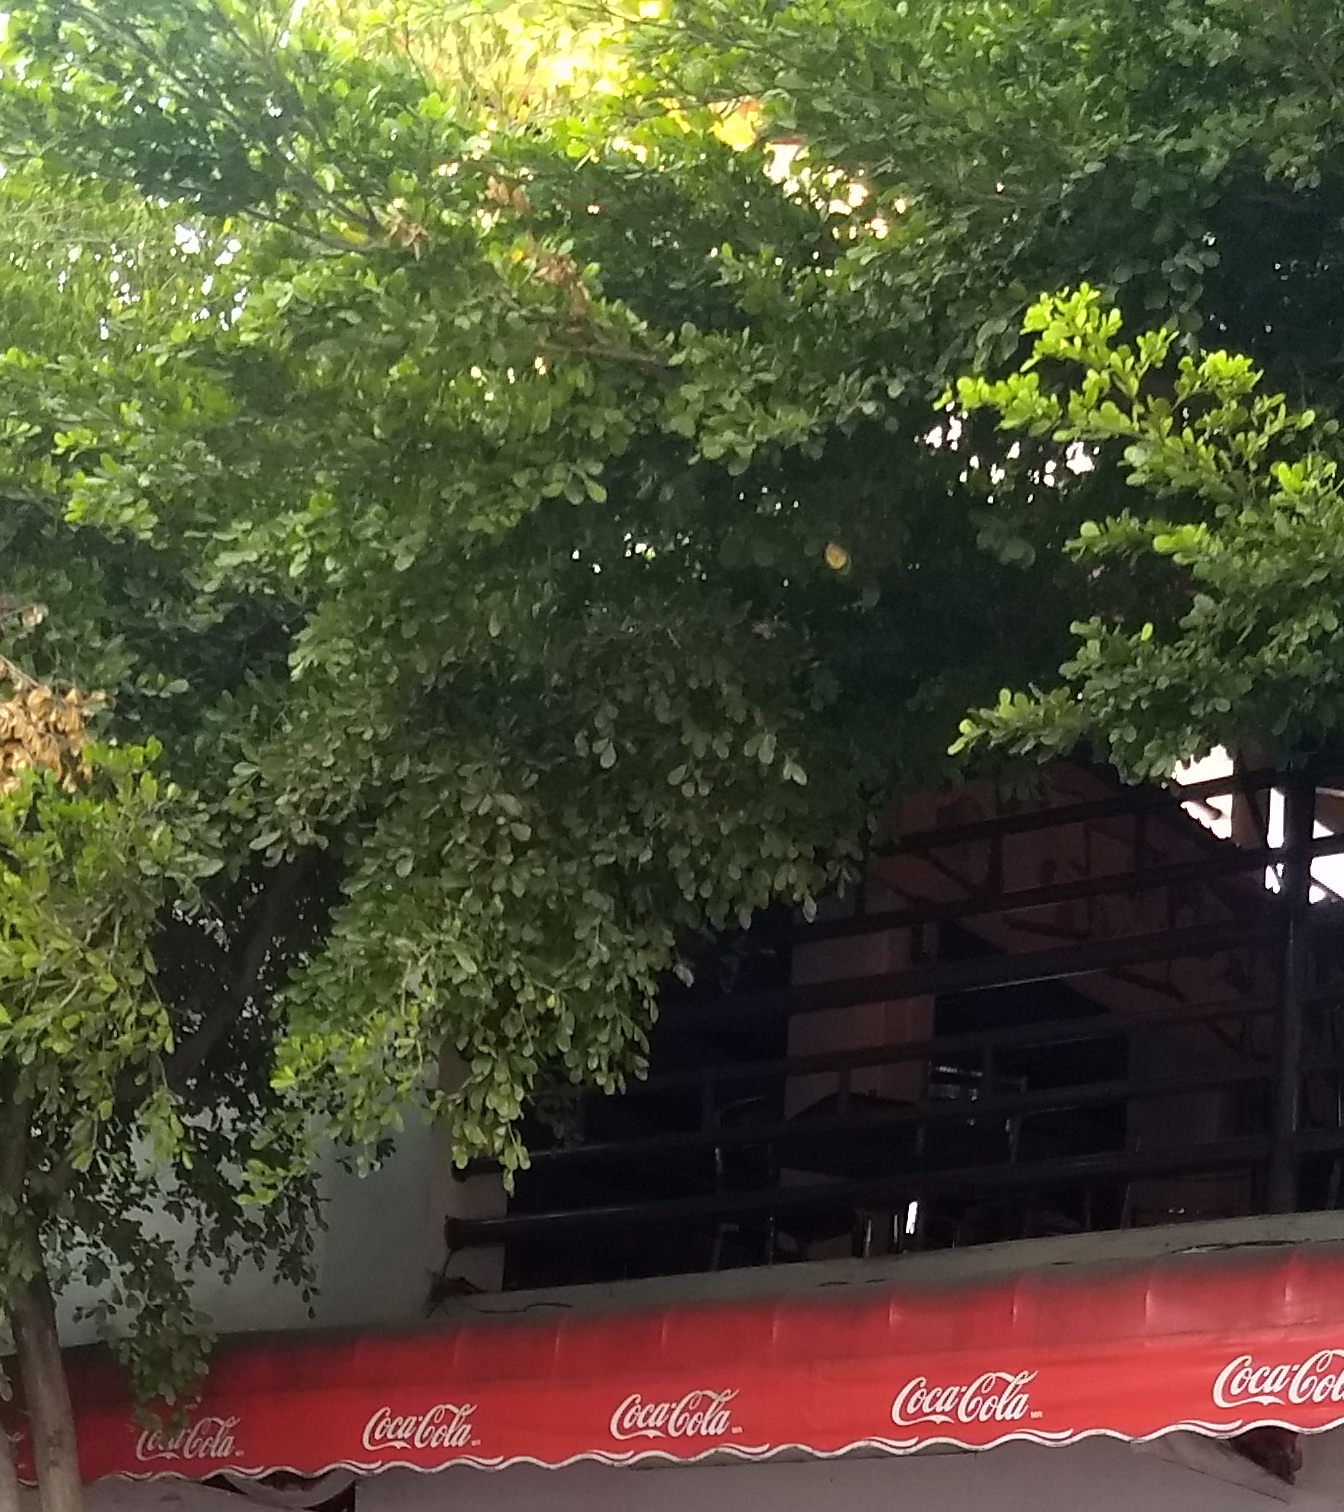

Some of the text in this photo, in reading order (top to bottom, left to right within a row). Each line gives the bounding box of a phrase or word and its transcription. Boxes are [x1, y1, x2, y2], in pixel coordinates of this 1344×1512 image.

[610, 1389, 739, 1440] Coca-Cola
[891, 1370, 1038, 1425] Coca-Cola
[362, 1404, 477, 1451] Coca-Cola
